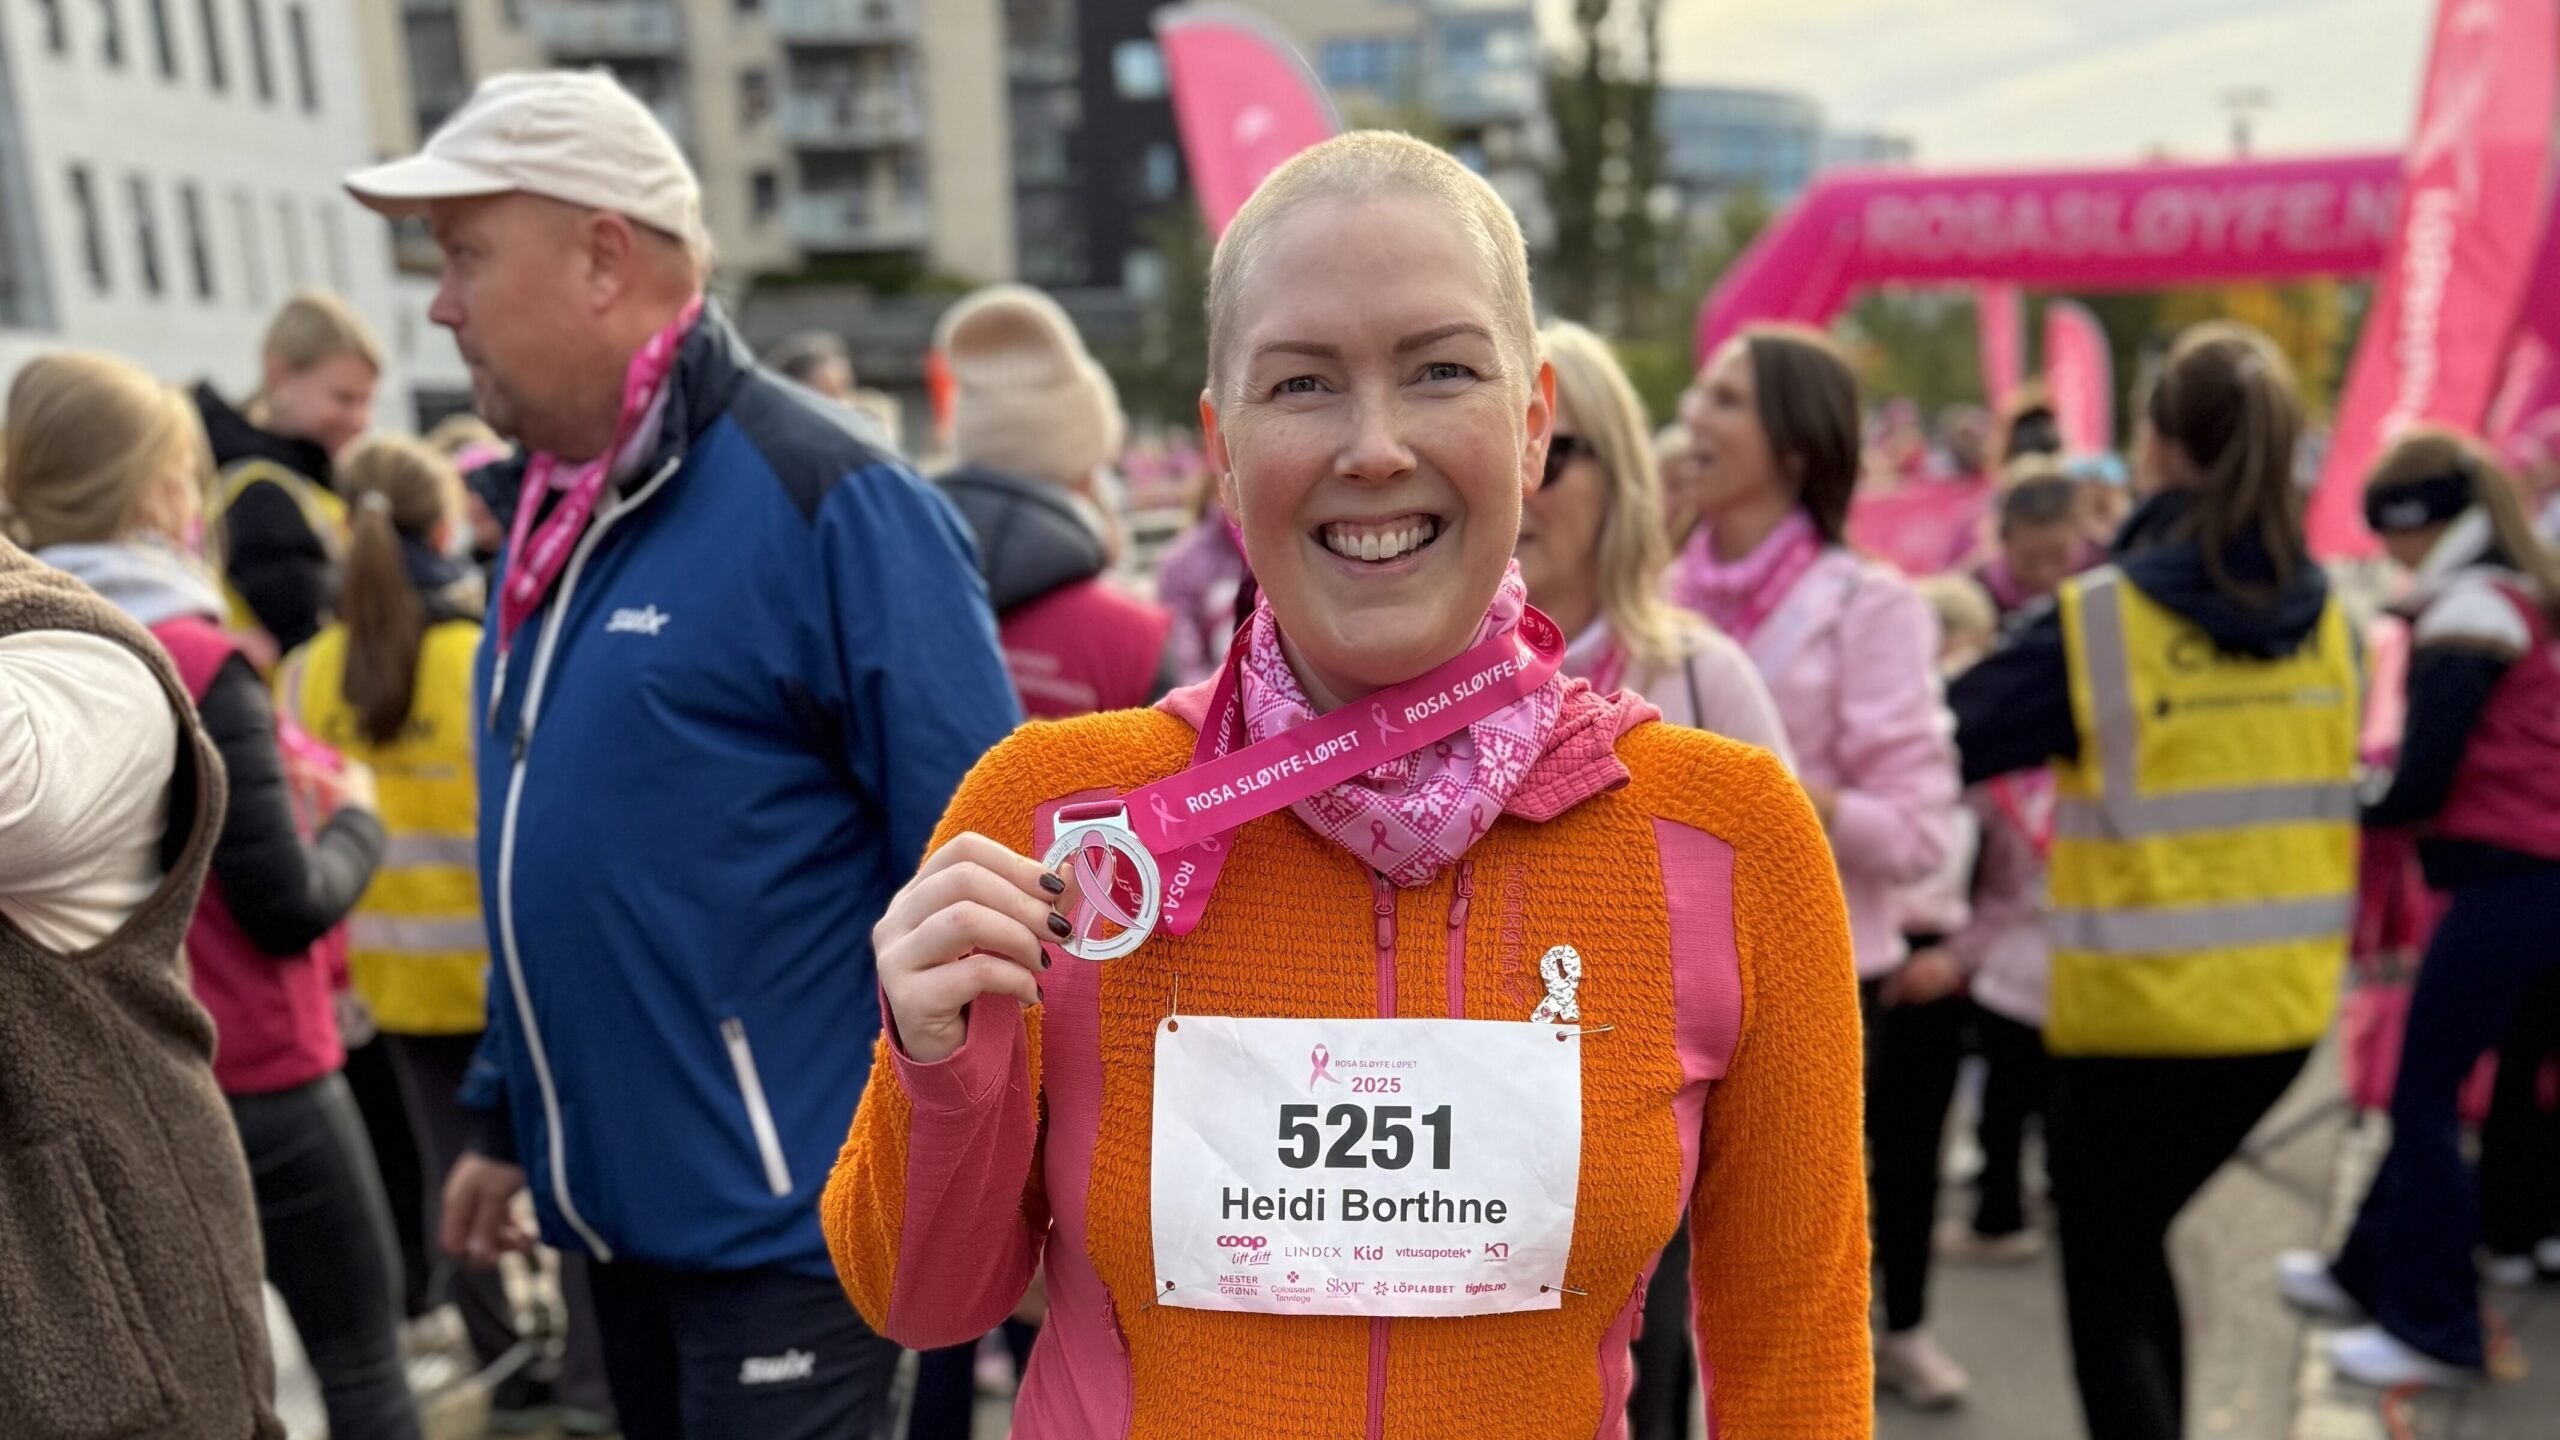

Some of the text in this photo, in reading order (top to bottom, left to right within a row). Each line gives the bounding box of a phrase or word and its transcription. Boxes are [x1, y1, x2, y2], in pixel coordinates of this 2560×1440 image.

[1404, 692, 1452, 724] ROSA
[1185, 730, 1360, 813] ROSA SLØYFE-LØPET
[1163, 860, 1196, 910] ROSA
[1334, 1060, 1358, 1068] ROSA
[1351, 1076, 1402, 1093] 2025
[1278, 1103, 1452, 1170] 5251
[1222, 1186, 1507, 1224] Heidi Borthne
[1216, 1235, 1267, 1250] coop
[1354, 1245, 1383, 1261] Kid
[1220, 1274, 1258, 1284] MESTER
[1325, 1277, 1362, 1296] Skyr
[1220, 1286, 1258, 1296] GRØNN
[1393, 1282, 1455, 1294] LÖPLABBET
[1465, 1282, 1507, 1296] tights.no
